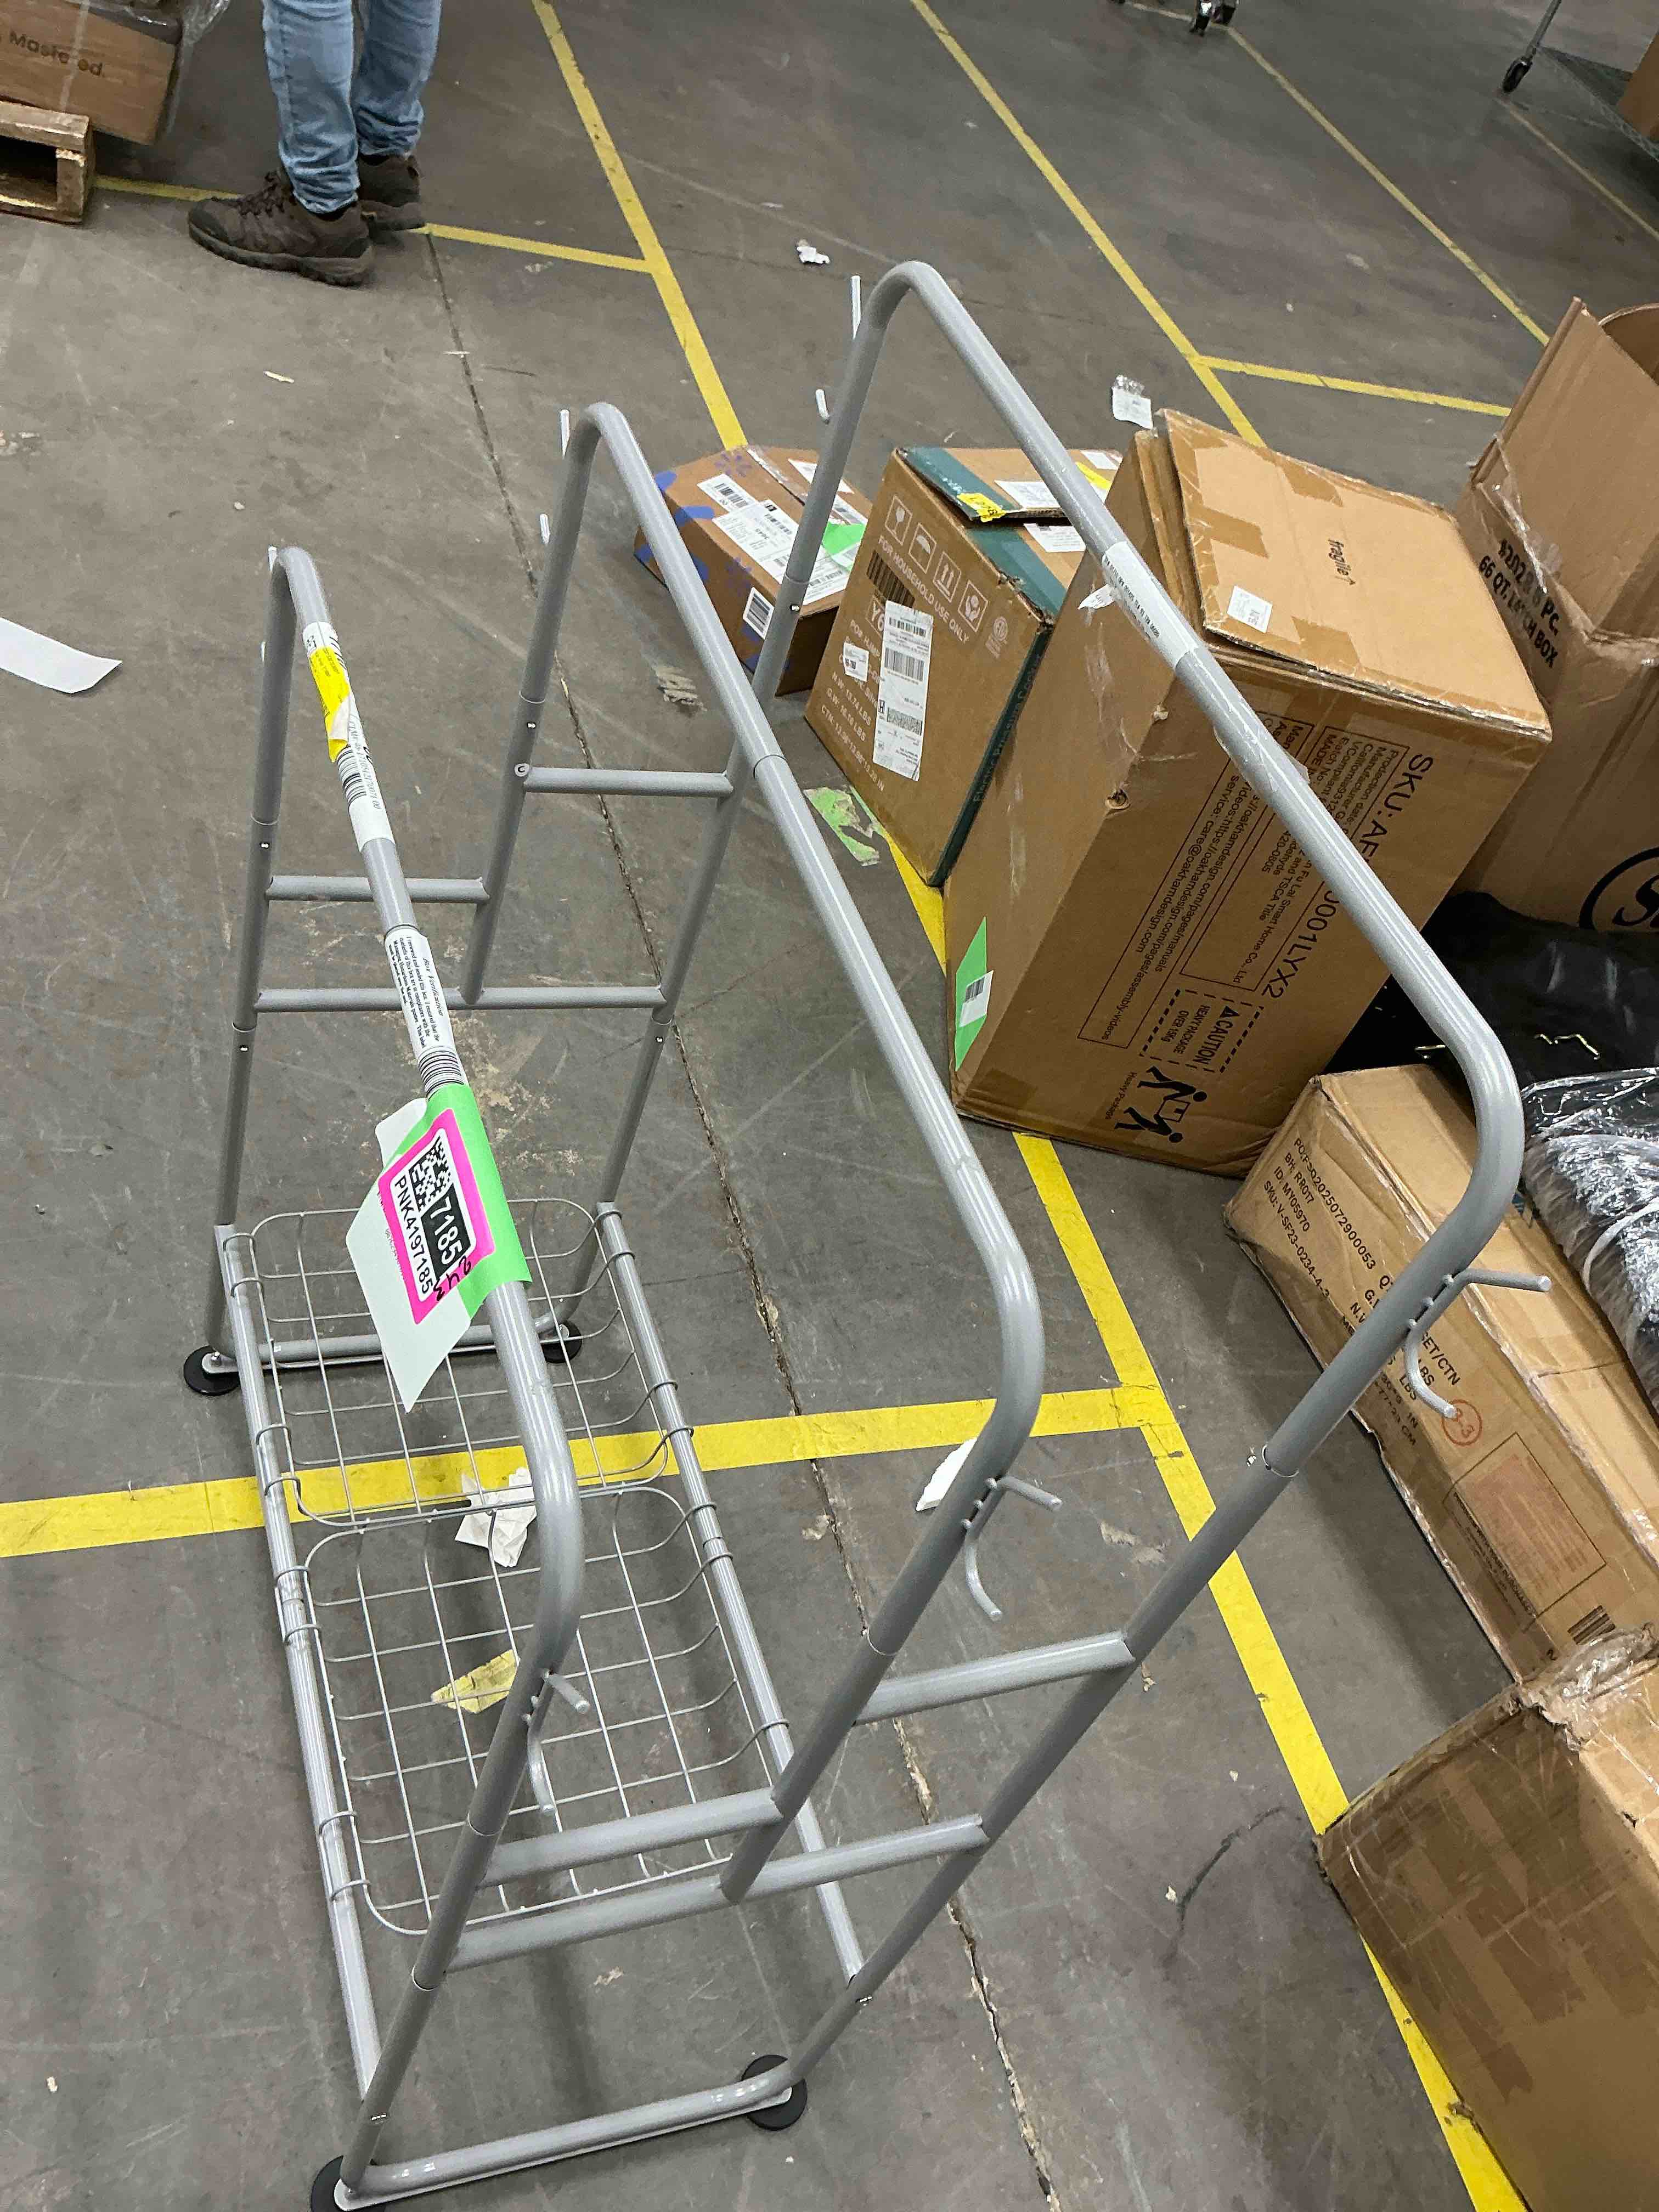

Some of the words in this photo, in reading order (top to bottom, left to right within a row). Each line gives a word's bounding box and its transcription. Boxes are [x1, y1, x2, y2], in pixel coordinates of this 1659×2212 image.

[10, 31, 105, 77] Masteed.
[878, 535, 893, 556] FOR
[893, 552, 935, 605] HOUSEHOLD
[934, 601, 950, 624] USE
[949, 618, 969, 645] ONLY
[1479, 555, 1496, 578] 66
[1493, 572, 1511, 600] QT.
[1534, 629, 1558, 668] BOX
[1312, 734, 1337, 766] MADE
[1378, 754, 1434, 817] SKU:
[1136, 820, 1215, 953] care@oakhamdesign.com
[1269, 877, 1293, 901] TSCA
[1269, 899, 1291, 924] Smart
[1254, 926, 1275, 951] Home
[1172, 1010, 1189, 1028] OVER
[1189, 1005, 1211, 1025] HEAVY
[1172, 1025, 1198, 1053] PACKAGE
[1192, 1020, 1234, 1064] CAUTION
[430, 1196, 462, 1265] 7185
[1282, 1183, 1310, 1232] MY05970
[395, 1175, 433, 1295] PNK4197185
[1264, 1180, 1278, 1207] SKU:
[1277, 1204, 1330, 1296] V-SF23-0234-4-3
